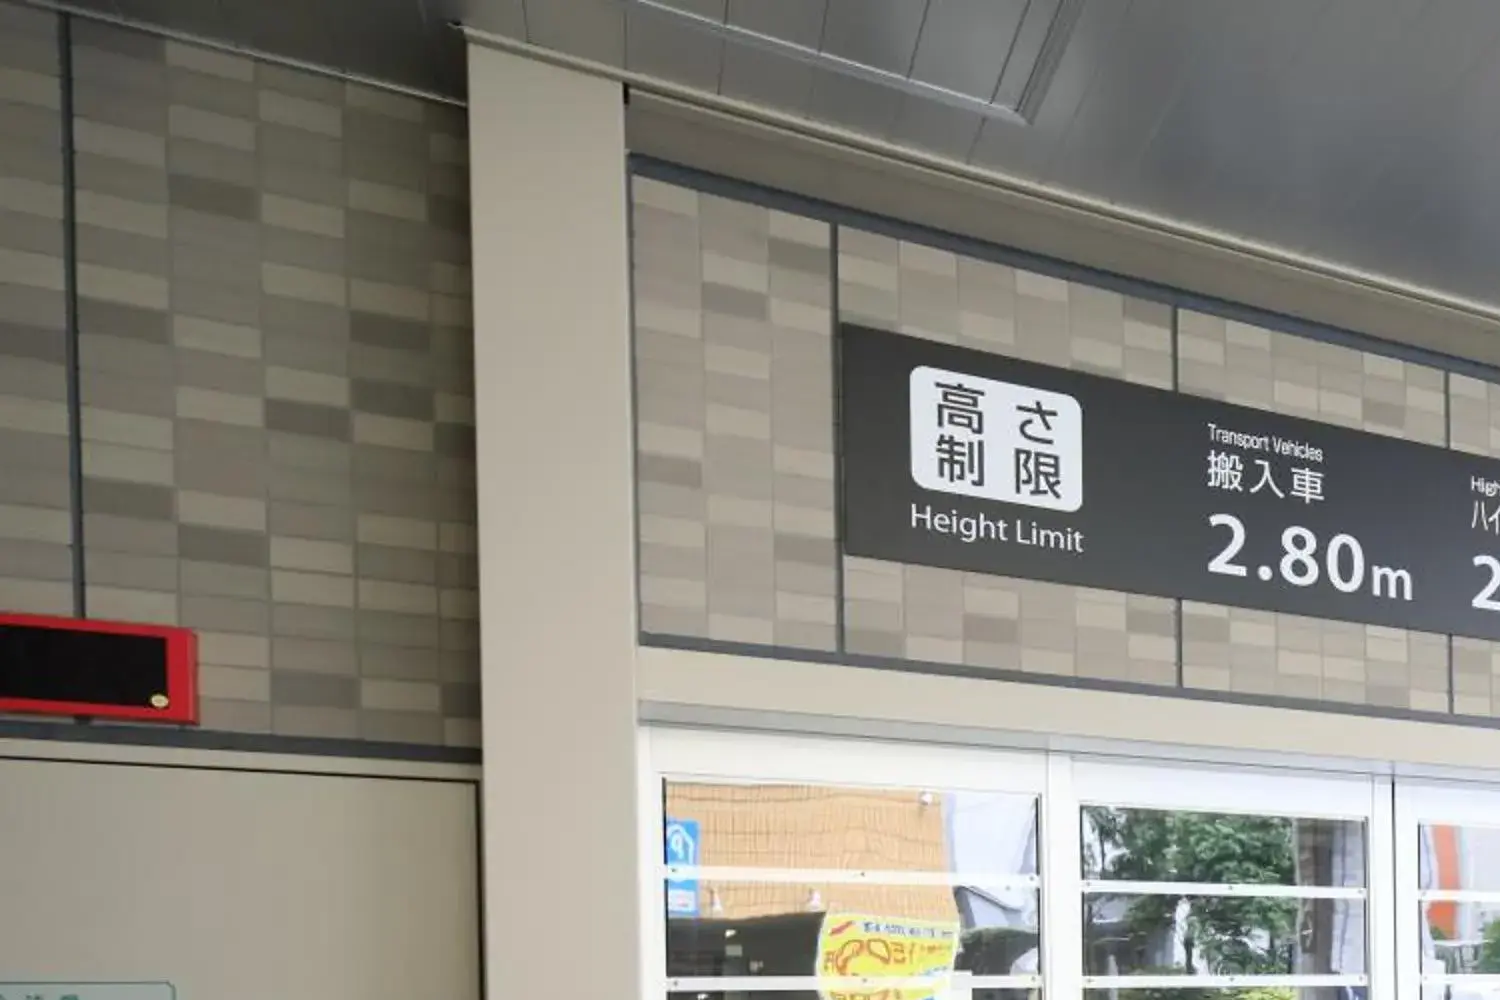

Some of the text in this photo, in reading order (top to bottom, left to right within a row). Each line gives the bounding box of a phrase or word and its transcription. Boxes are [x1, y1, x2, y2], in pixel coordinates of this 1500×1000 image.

[1207, 422, 1324, 463] Transport Vehicles
[1207, 449, 1325, 504] 搬入車
[911, 502, 1085, 553] Height Limit
[1207, 513, 1413, 602] 2.80m
